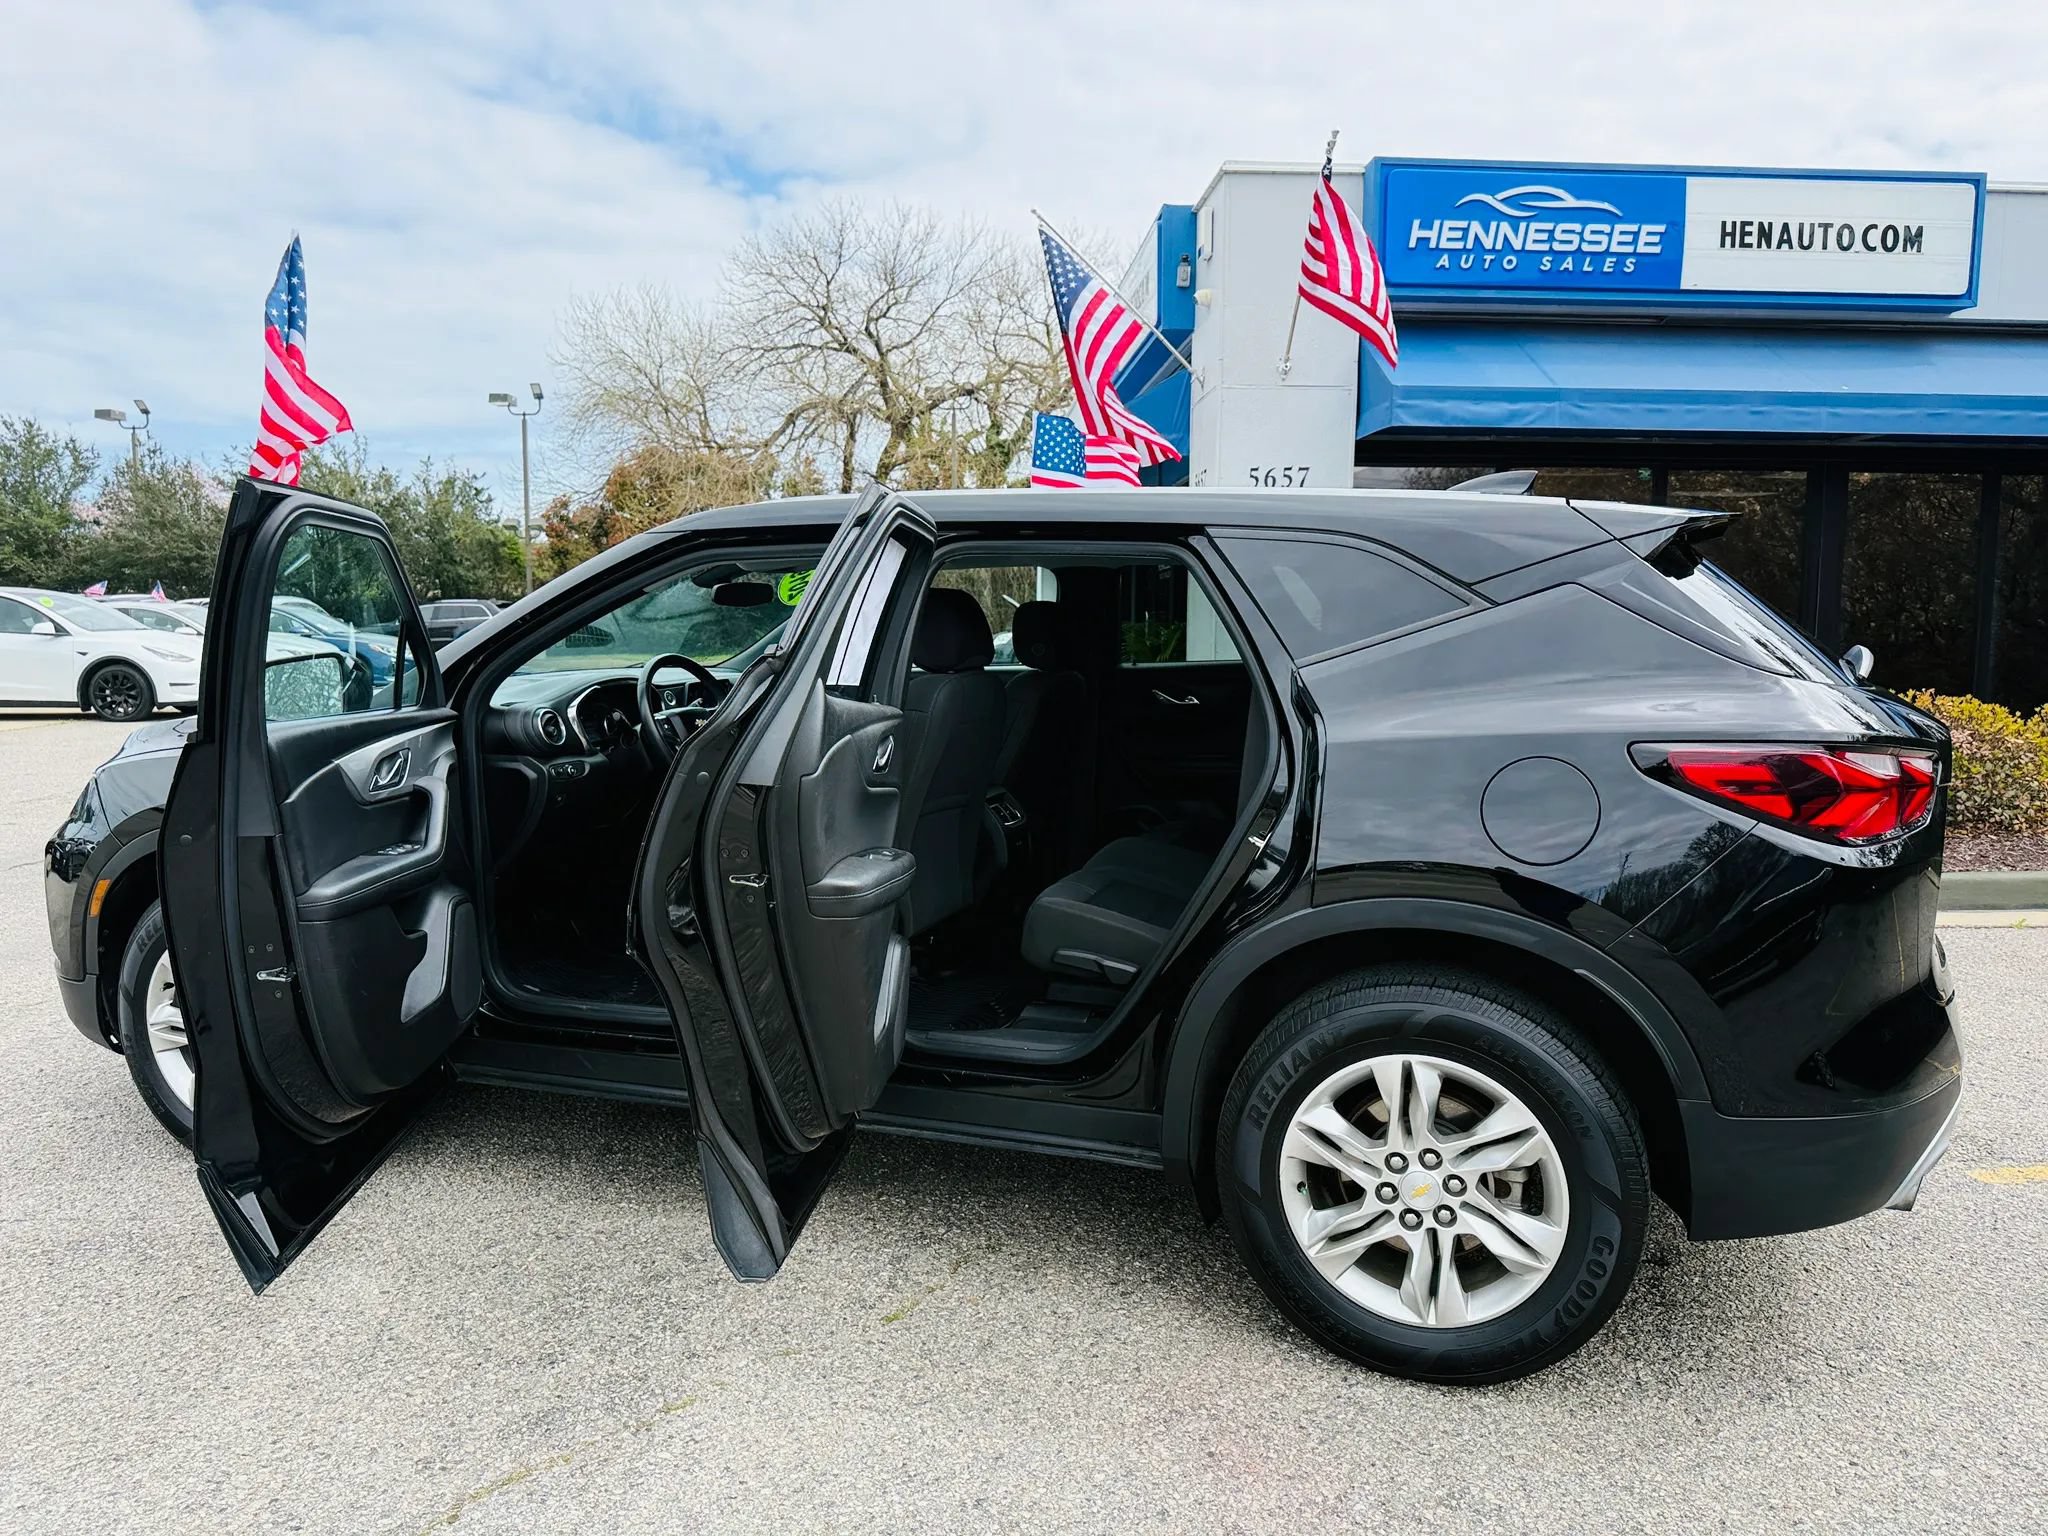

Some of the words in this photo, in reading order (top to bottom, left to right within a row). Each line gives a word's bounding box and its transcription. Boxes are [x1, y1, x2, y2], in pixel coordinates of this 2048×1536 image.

[1408, 218, 1667, 254] HENNESSEE
[1436, 254, 1518, 271] AUTO
[1539, 256, 1637, 273] SALES
[1249, 466, 1311, 488] 5657
